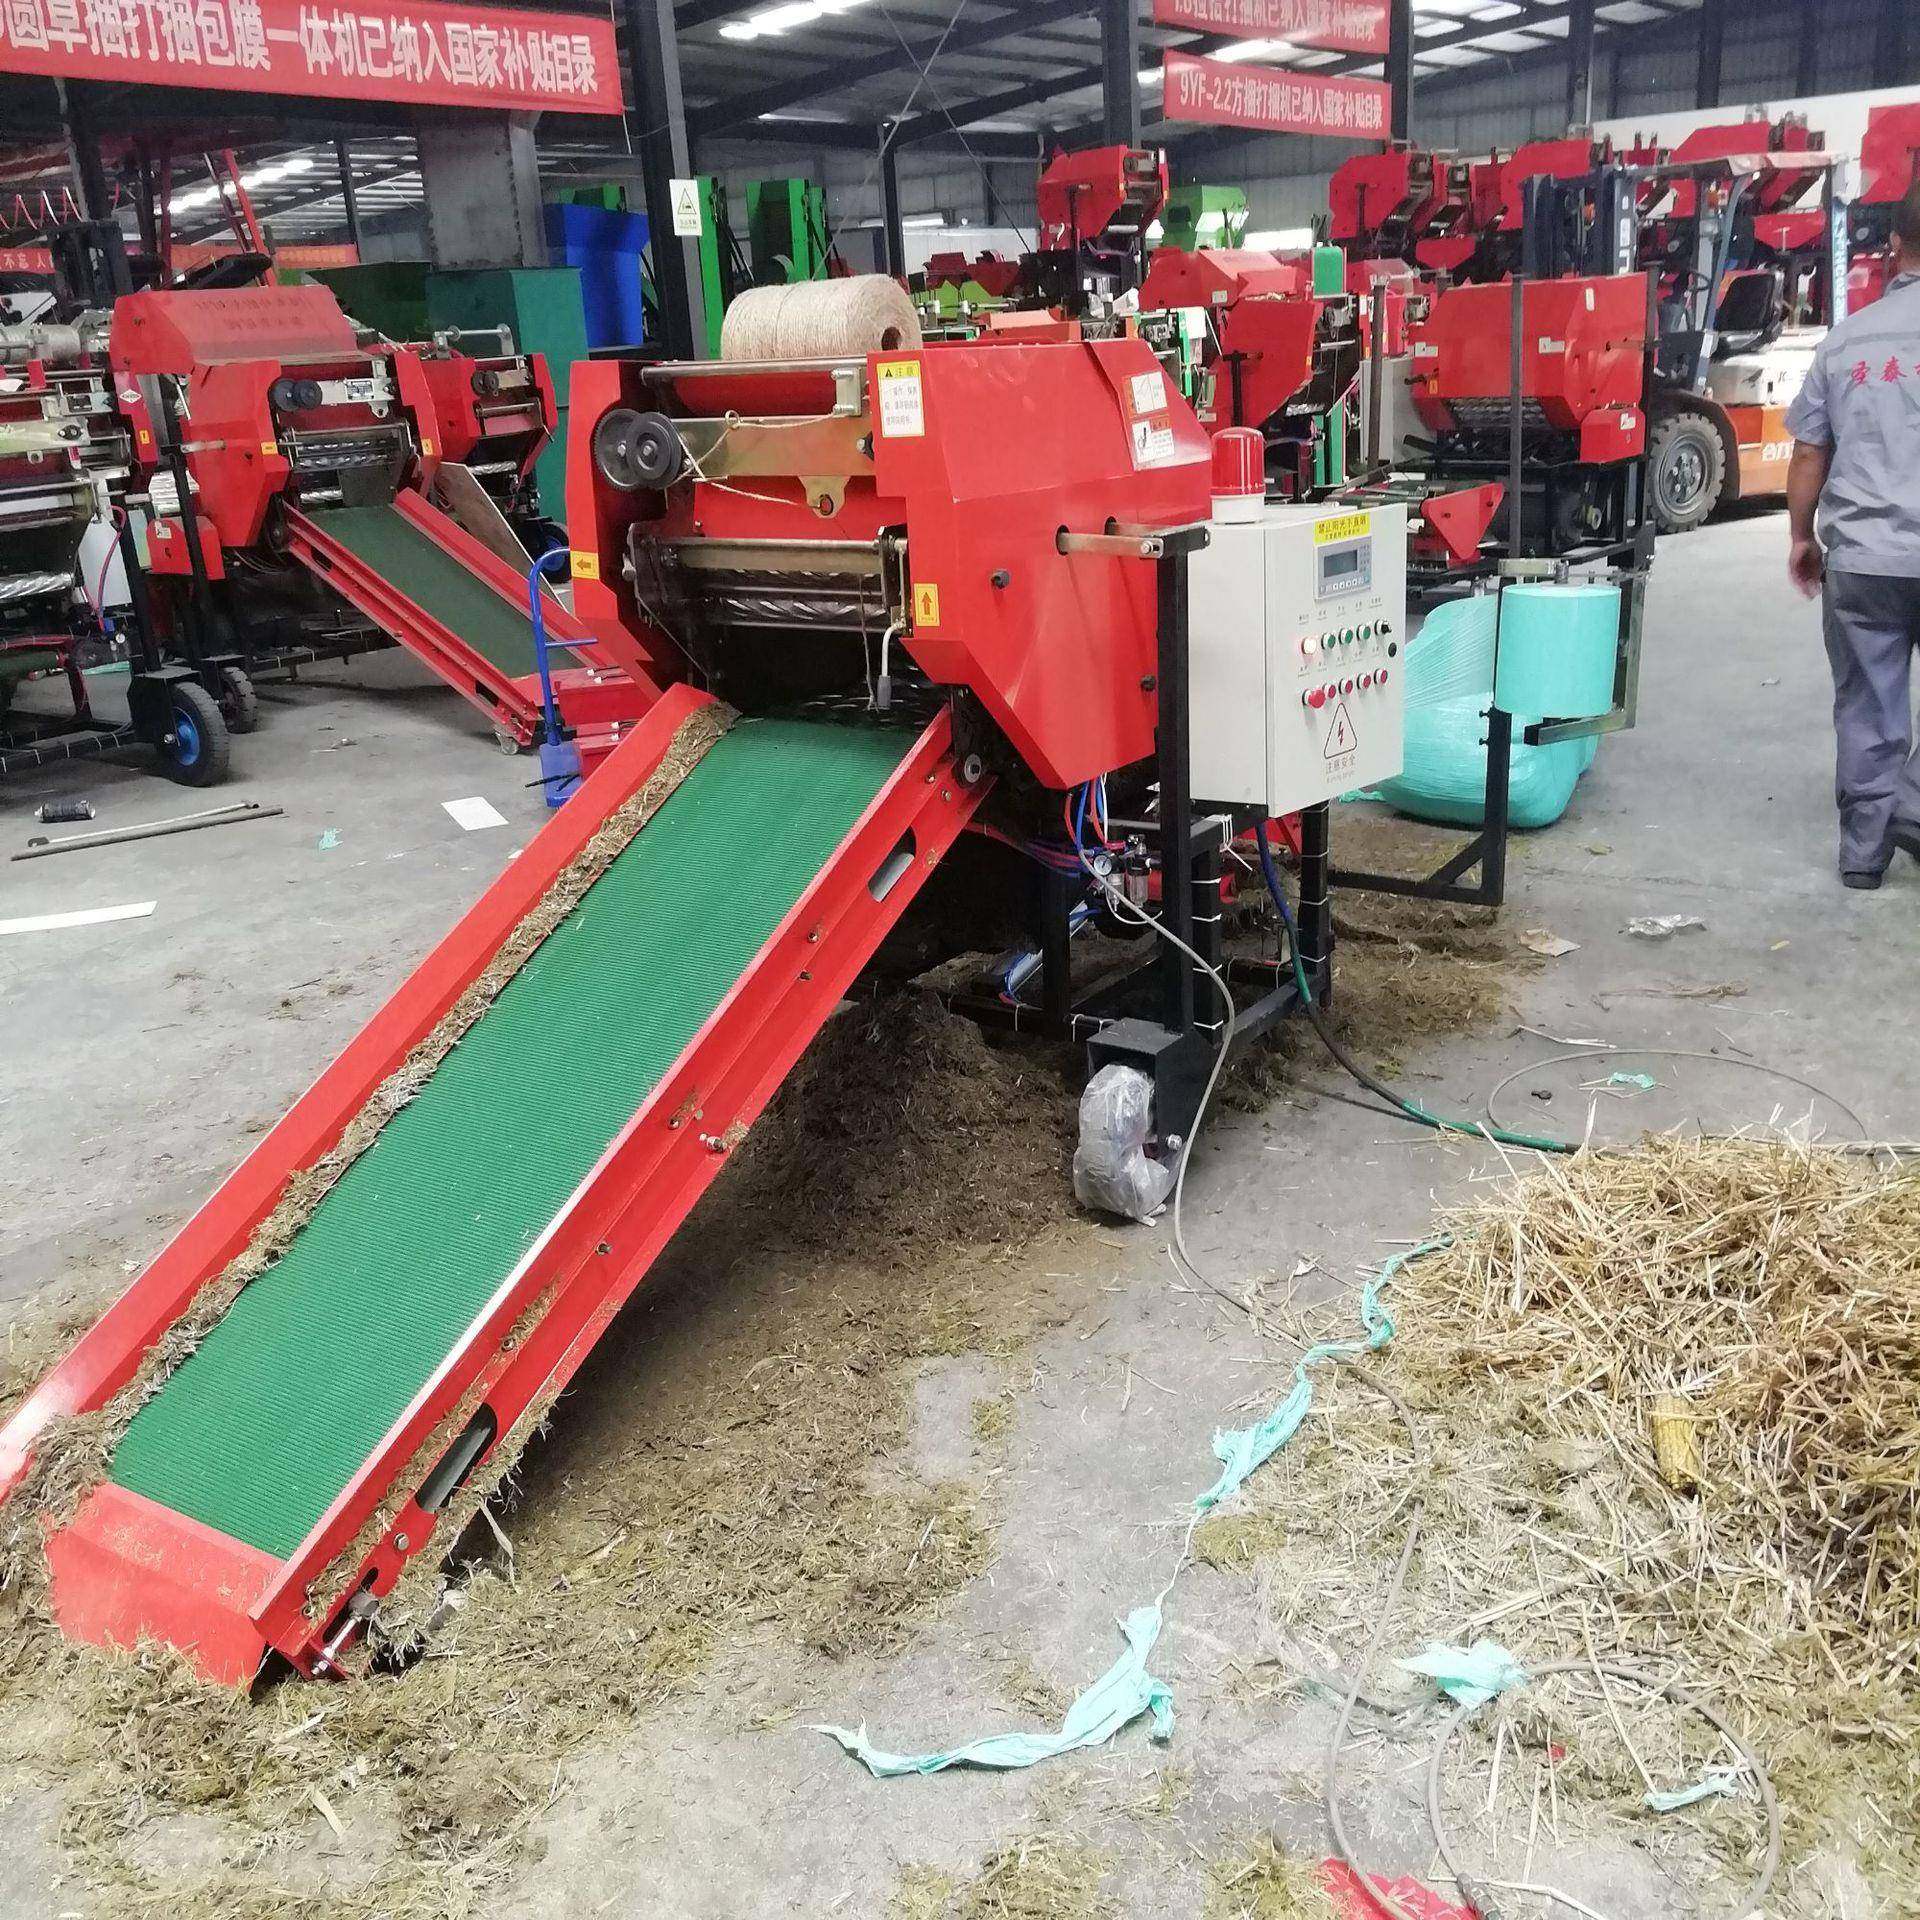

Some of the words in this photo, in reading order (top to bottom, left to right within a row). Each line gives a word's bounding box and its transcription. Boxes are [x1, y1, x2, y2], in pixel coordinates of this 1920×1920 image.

[0, 0, 598, 95] 圆草捆打捆包膜一体机已纳入国家补贴目录
